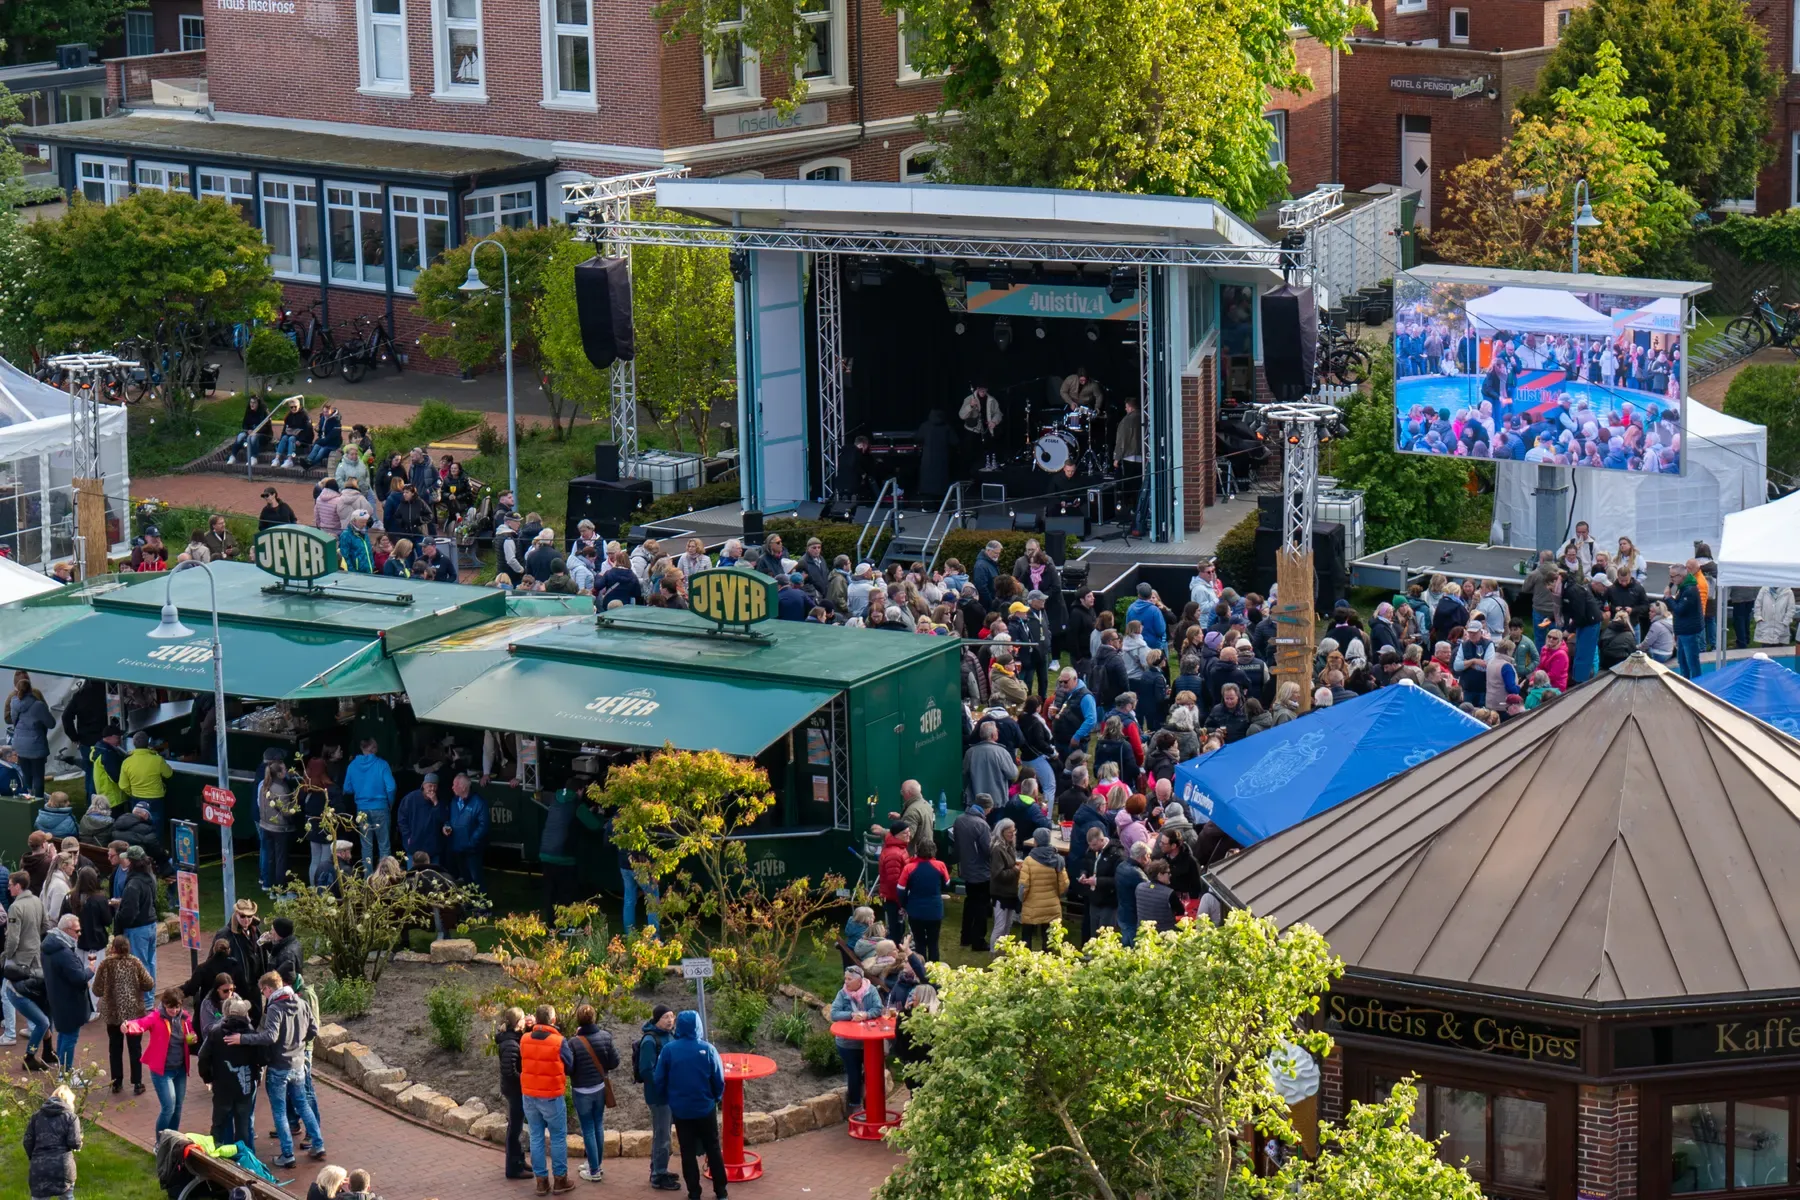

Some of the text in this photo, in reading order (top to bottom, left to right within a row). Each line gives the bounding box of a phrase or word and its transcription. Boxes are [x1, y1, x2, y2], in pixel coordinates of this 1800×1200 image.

[1390, 79, 1457, 91] HOTEL & PENSION
[257, 532, 326, 577] JEVER
[692, 573, 767, 621] JEVER
[147, 645, 214, 663] JEVER
[585, 696, 660, 716] JEVER
[919, 708, 942, 734] JEVER
[489, 807, 513, 824] EVER
[753, 859, 786, 876] JEVER
[1330, 996, 1577, 1062] Softeis & Crêpes
